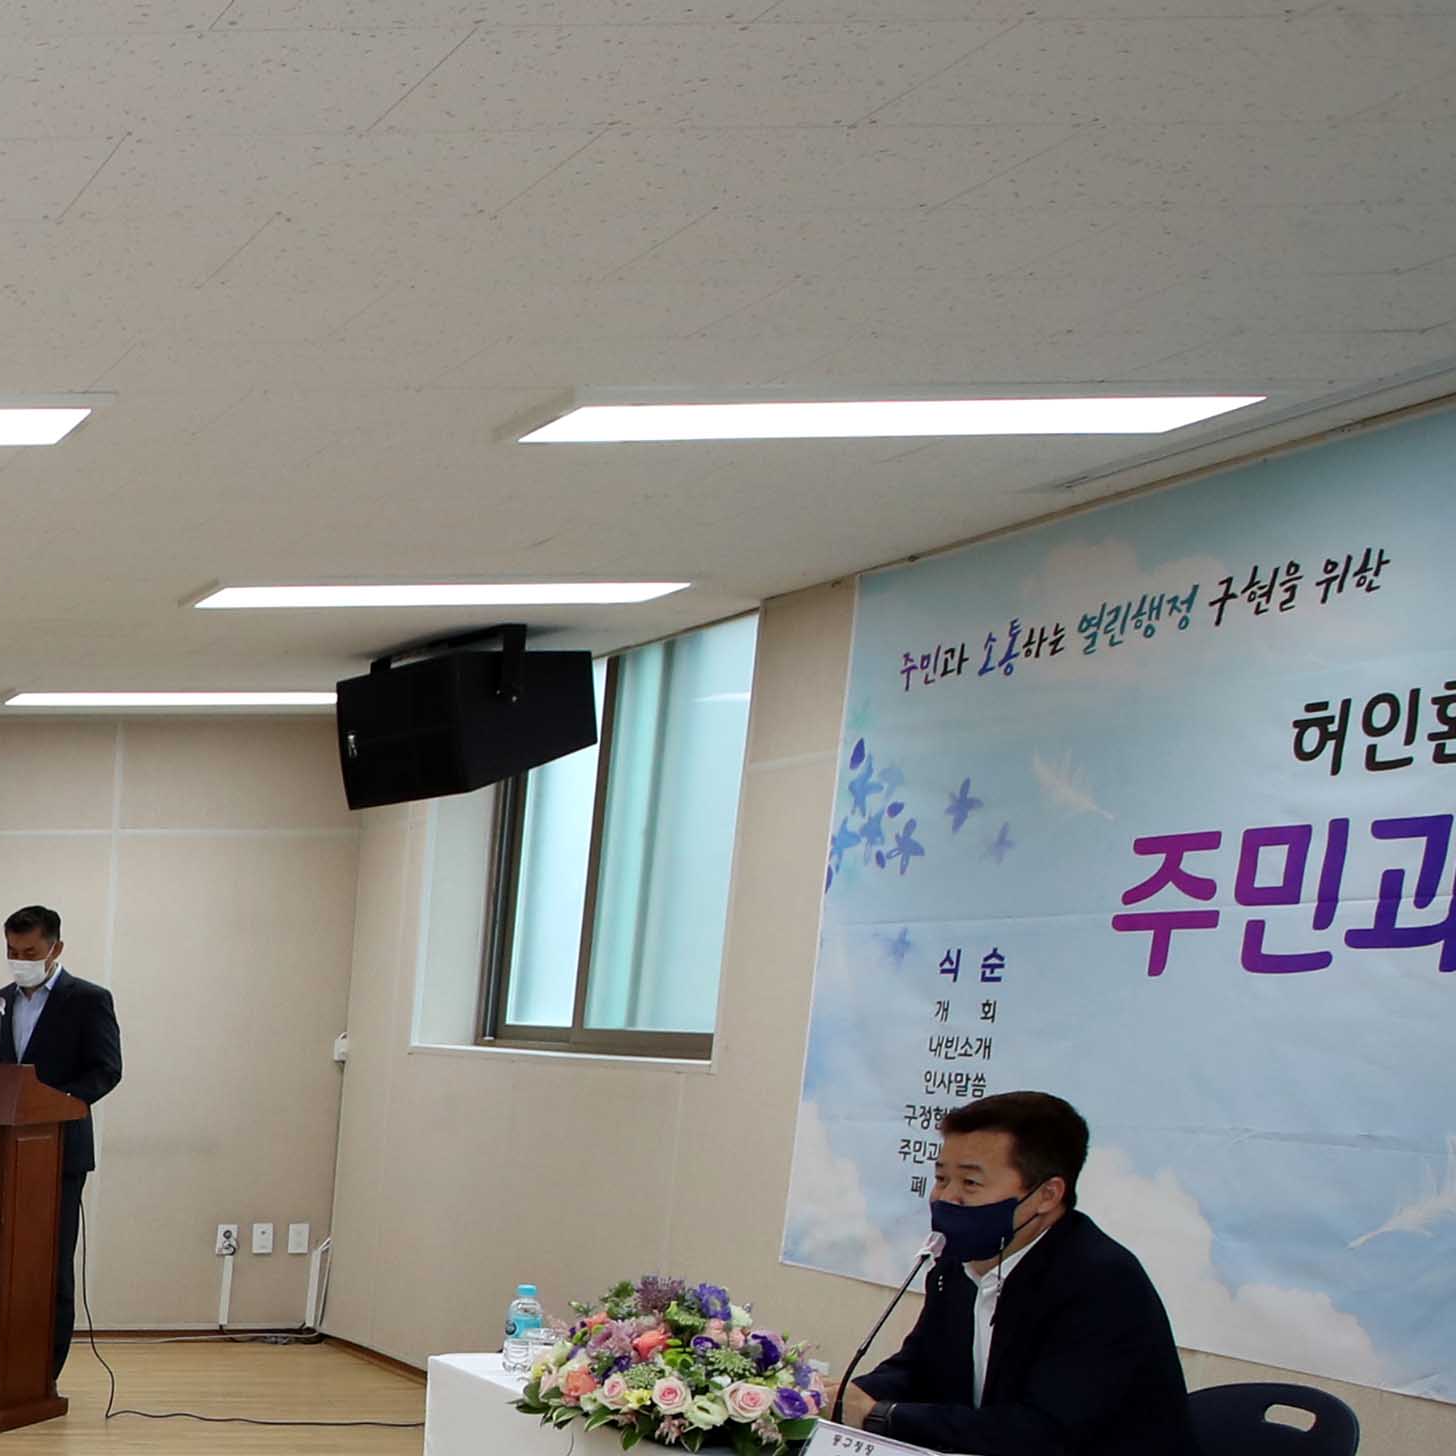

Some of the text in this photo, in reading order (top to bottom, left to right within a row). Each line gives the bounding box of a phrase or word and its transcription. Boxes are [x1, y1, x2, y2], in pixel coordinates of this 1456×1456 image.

[900, 547, 1392, 691] 주민과 소통하는 열린행정 구현을 위한
[1111, 813, 1456, 978] 주민과
[924, 1070, 987, 1098] 인사말씀
[928, 1036, 993, 1060] 내빈소개
